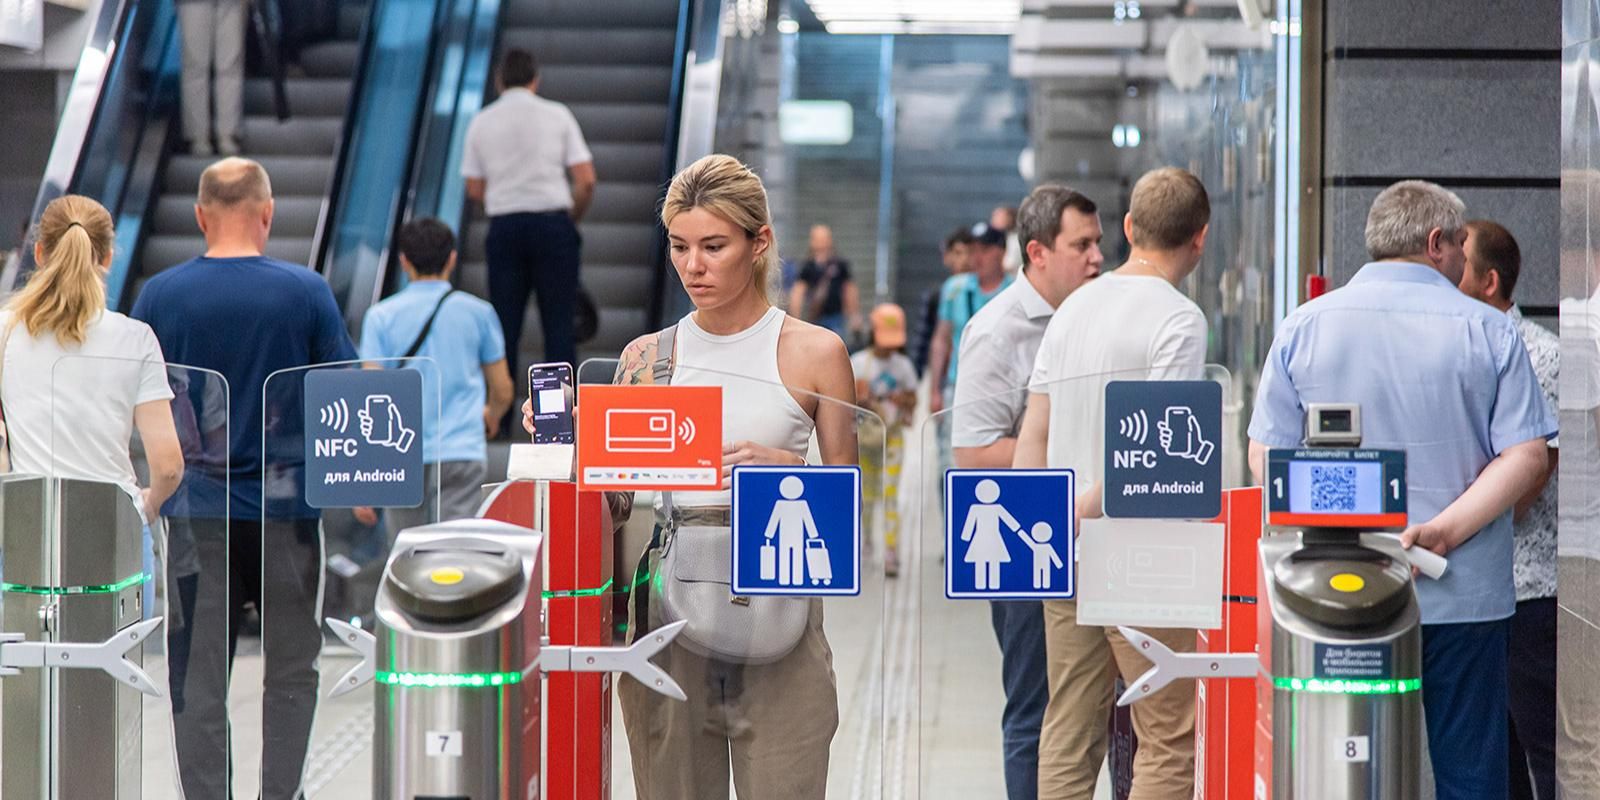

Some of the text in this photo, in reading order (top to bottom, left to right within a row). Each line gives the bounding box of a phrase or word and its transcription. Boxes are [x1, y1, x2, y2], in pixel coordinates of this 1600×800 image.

[314, 438, 358, 457] NFC
[1113, 450, 1157, 469] NFC
[324, 468, 405, 485] для Android
[1122, 481, 1204, 496] для Android
[1273, 477, 1283, 499] 1
[1390, 478, 1400, 500] 1
[1326, 648, 1343, 657] Для
[439, 735, 449, 752] 7
[1345, 740, 1357, 758] 8
